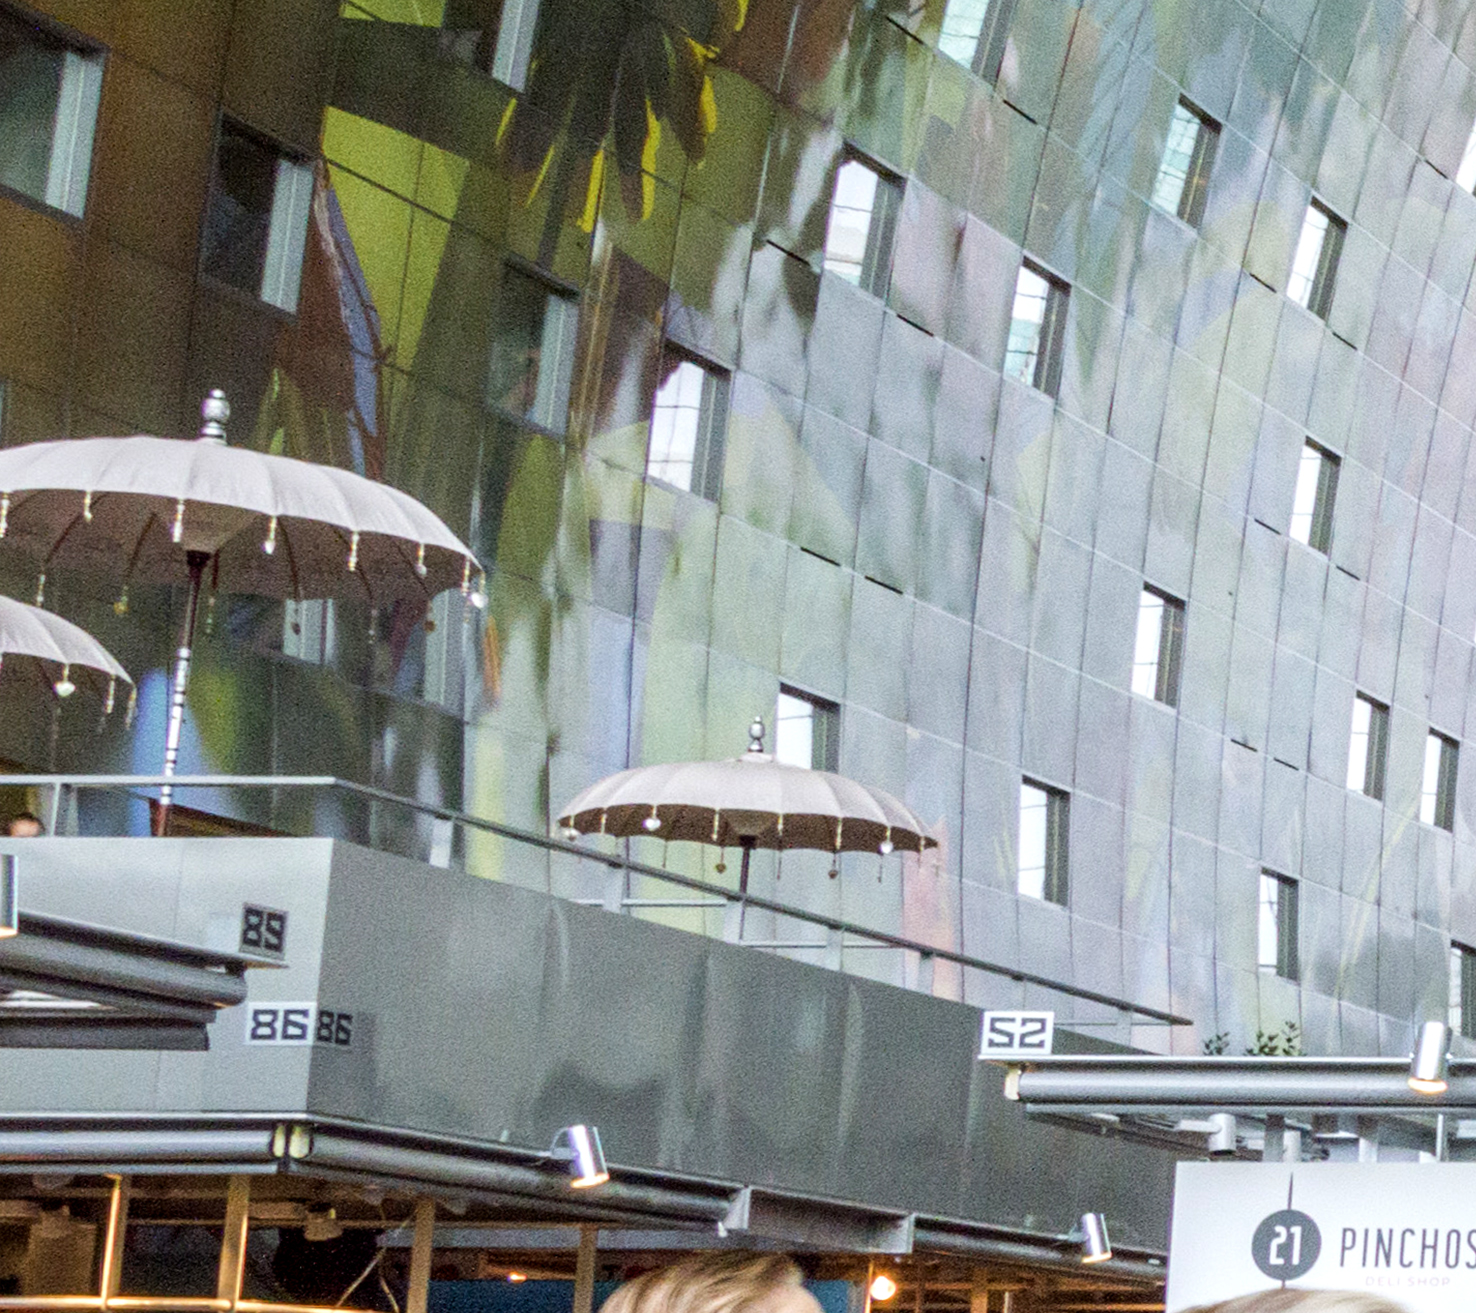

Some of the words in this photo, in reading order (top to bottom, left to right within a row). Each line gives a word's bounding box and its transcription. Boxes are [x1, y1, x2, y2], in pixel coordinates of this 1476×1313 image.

[243, 907, 287, 953] 89
[251, 1009, 309, 1040] 86
[317, 1009, 353, 1046] 86
[988, 1017, 1047, 1048] 52
[1269, 1225, 1302, 1266] 21
[1366, 1276, 1400, 1287] DELI
[1408, 1276, 1450, 1288] SHOP
